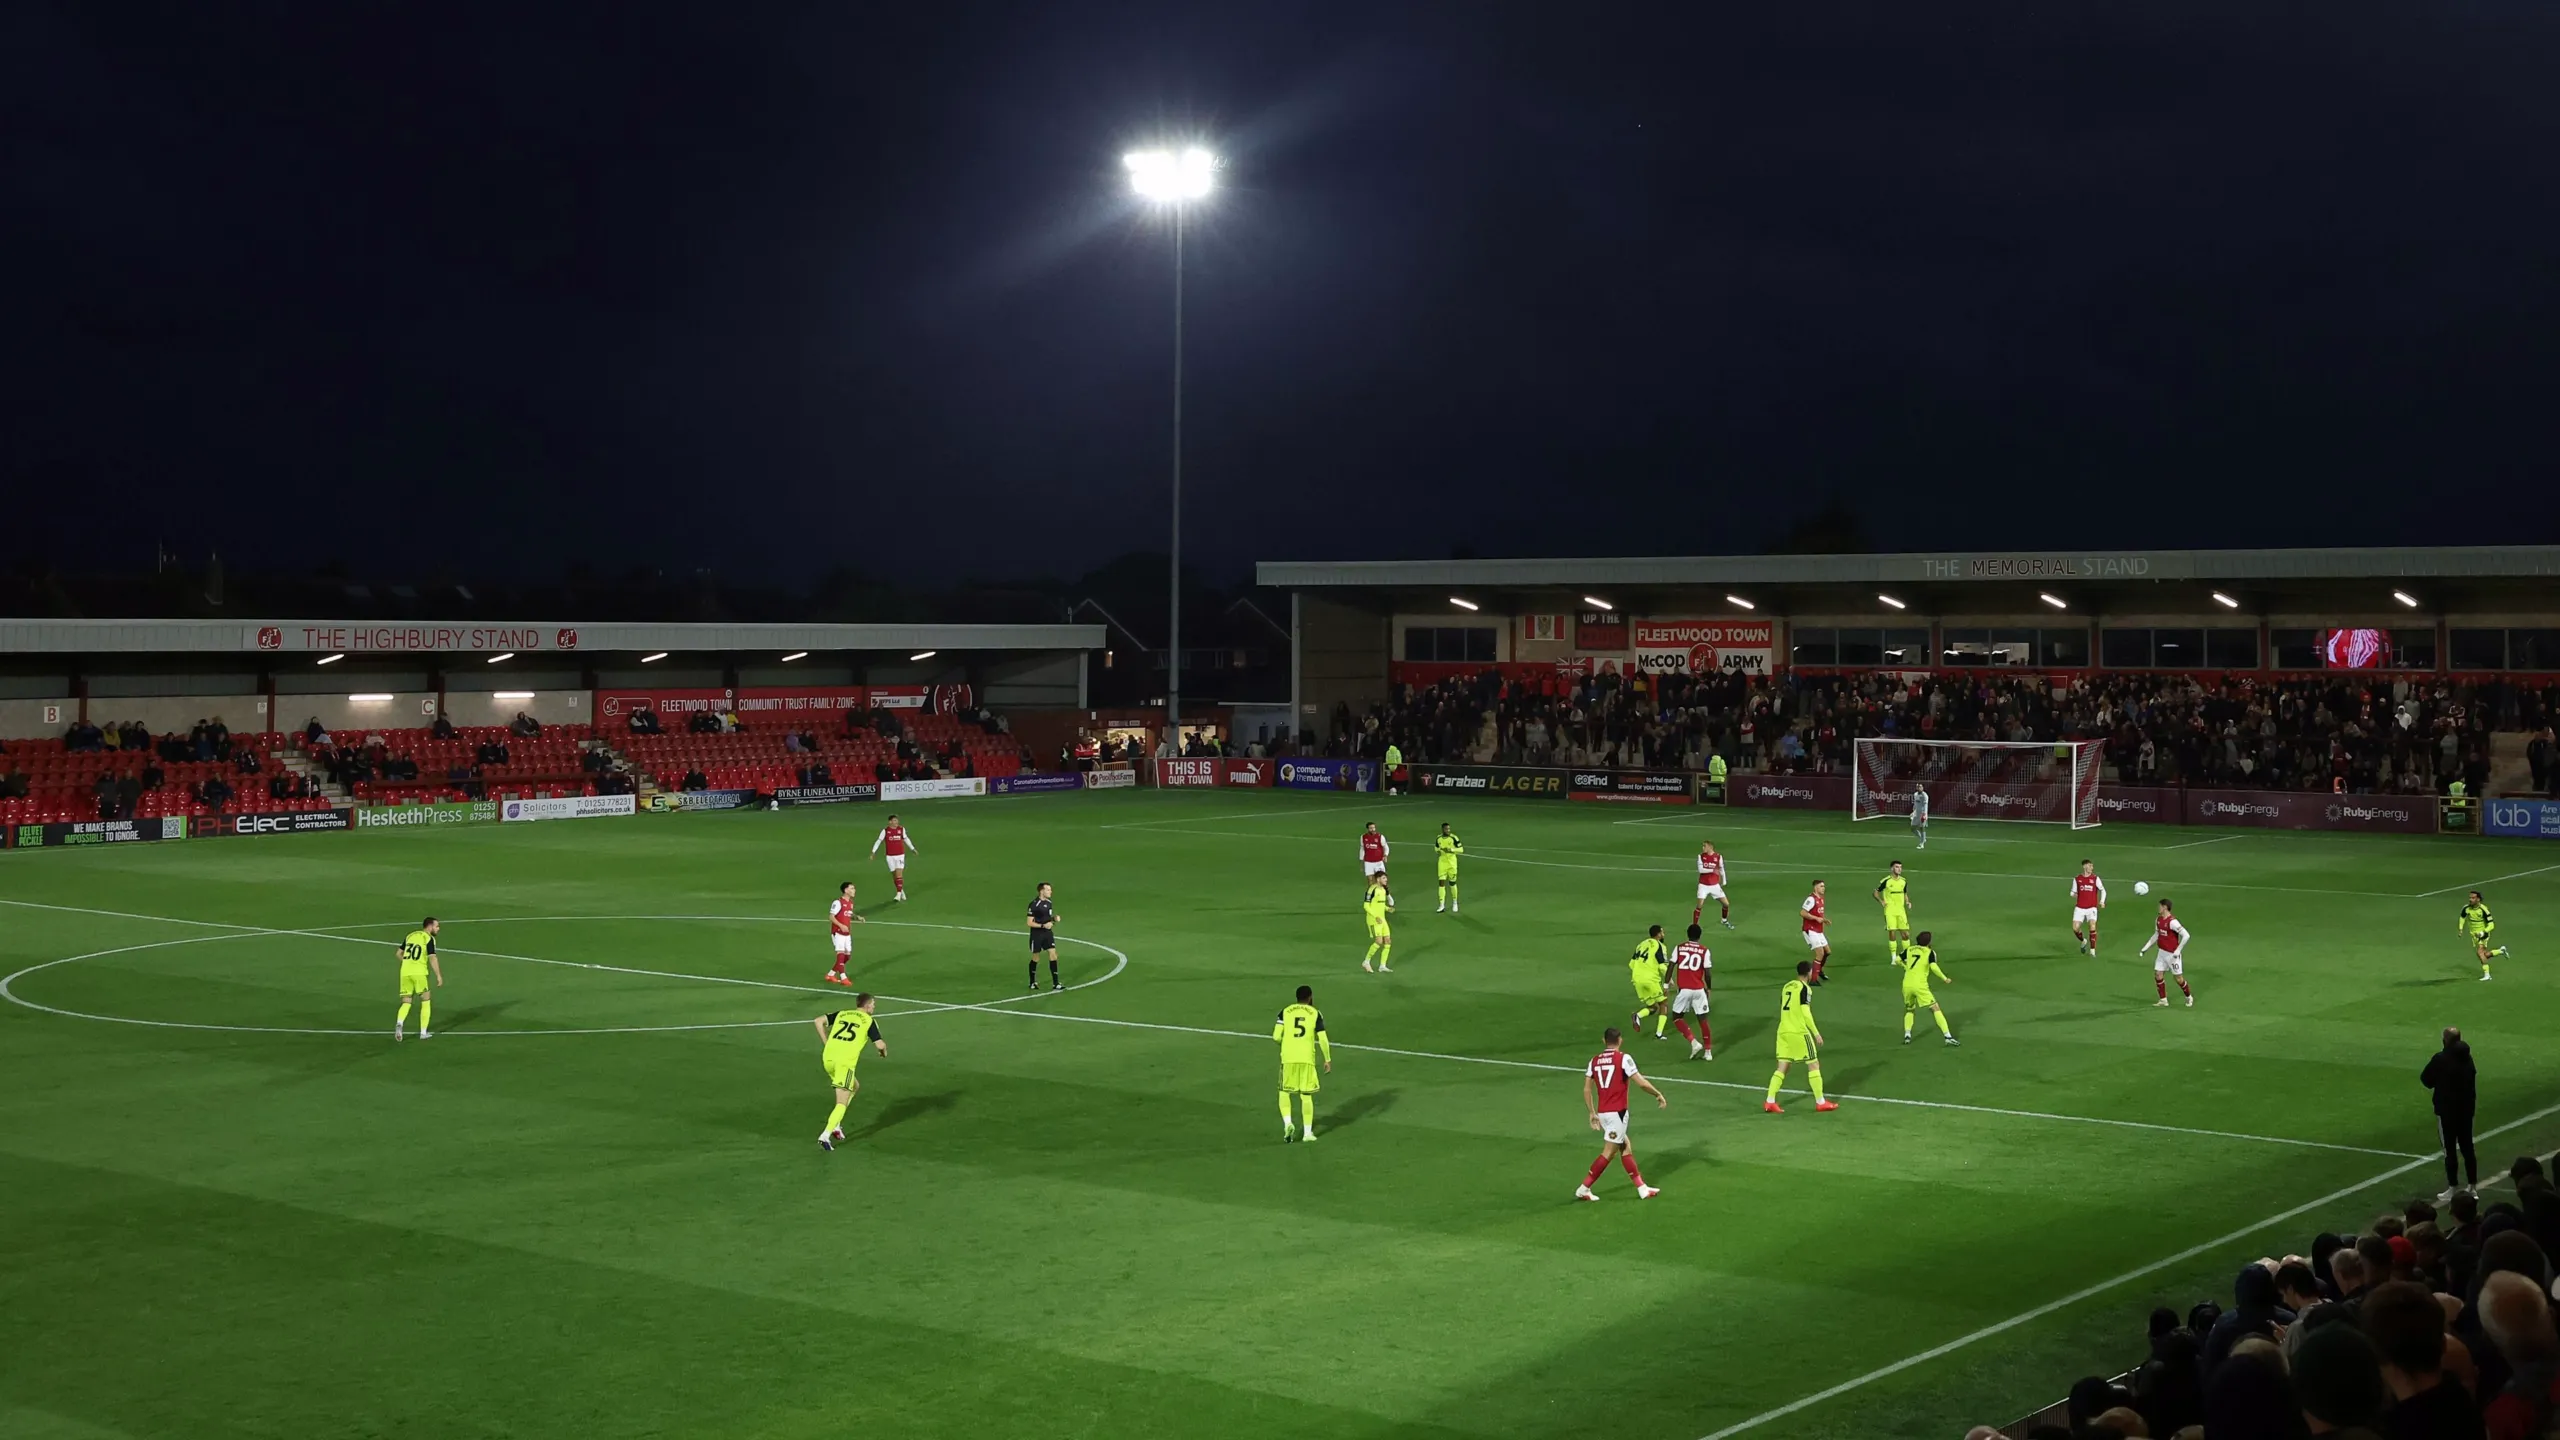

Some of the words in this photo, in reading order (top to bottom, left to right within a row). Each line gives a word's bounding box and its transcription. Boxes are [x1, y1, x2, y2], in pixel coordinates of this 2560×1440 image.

[1923, 560, 1960, 577] THE
[1971, 559, 2076, 576] MEMORIAL
[2083, 557, 2149, 576] STAND
[1582, 613, 1597, 624] UP
[1600, 613, 1620, 624] THE
[302, 628, 346, 648] THE
[354, 629, 465, 648] HIGHBURY
[472, 629, 539, 648] STAND
[1637, 628, 1722, 642] FLEETWOOD
[1725, 628, 1770, 642] TOWN
[1638, 654, 1686, 668] McCOD
[1723, 655, 1764, 668] ARMY
[423, 701, 434, 714] C
[661, 699, 708, 712] FLEETWOOD
[710, 698, 733, 711] TOWN
[738, 698, 783, 711] COMMUNITY
[784, 697, 808, 710] TRUST
[809, 697, 835, 709] FAMILY
[836, 696, 855, 709] ZONE
[47, 707, 57, 722] B
[1167, 761, 1196, 775] THIS
[1199, 761, 1212, 775] IS
[1296, 766, 1327, 775] compare
[1168, 775, 1185, 785] OUR
[1187, 775, 1213, 785] TOWN
[1230, 771, 1257, 784] PUMA
[1435, 774, 1486, 788] Carabao
[1489, 775, 1560, 791] LAGER
[1663, 777, 1682, 785] quality
[777, 788, 802, 798] BYRNE
[803, 786, 835, 797] FUNERAL
[836, 784, 876, 795] DIRECTORS
[884, 784, 912, 793] HRRIS
[1656, 784, 1682, 792] business?
[1761, 786, 1814, 800] RubyEnergy
[584, 799, 606, 807] 01253
[607, 798, 631, 806] 778231
[695, 793, 742, 805] ELECTRICAL
[1980, 793, 2037, 808] RubyEnergy
[2096, 798, 2156, 813] RubyEnergy
[473, 802, 496, 811] 01253
[523, 803, 567, 812] Solicitors
[576, 805, 631, 816] phhsolicitors.co.uk
[2217, 802, 2279, 817] RubyEnergy
[2540, 804, 2558, 813] Are
[295, 813, 338, 821] ELECTRICAL
[358, 806, 463, 827] HeskethPress
[469, 811, 496, 821] 875484
[2343, 806, 2408, 822] RubyEnergy
[2492, 803, 2531, 827] lab
[18, 825, 44, 836] VELVET
[73, 823, 84, 833] WE
[85, 821, 105, 832] MAKE
[105, 820, 133, 832] BRANDS
[295, 820, 347, 829] CONTRACTORS
[64, 832, 104, 844] IMPOSSIBLE
[105, 831, 114, 841] TO
[115, 830, 140, 841] IGNORE.
[403, 943, 422, 961] 30
[1678, 951, 1702, 971] 20
[1910, 954, 1921, 969] 7
[1783, 991, 1792, 1010] 2
[832, 1020, 860, 1042] 25
[1293, 1016, 1306, 1038] 5
[1594, 1064, 1616, 1089] 17
